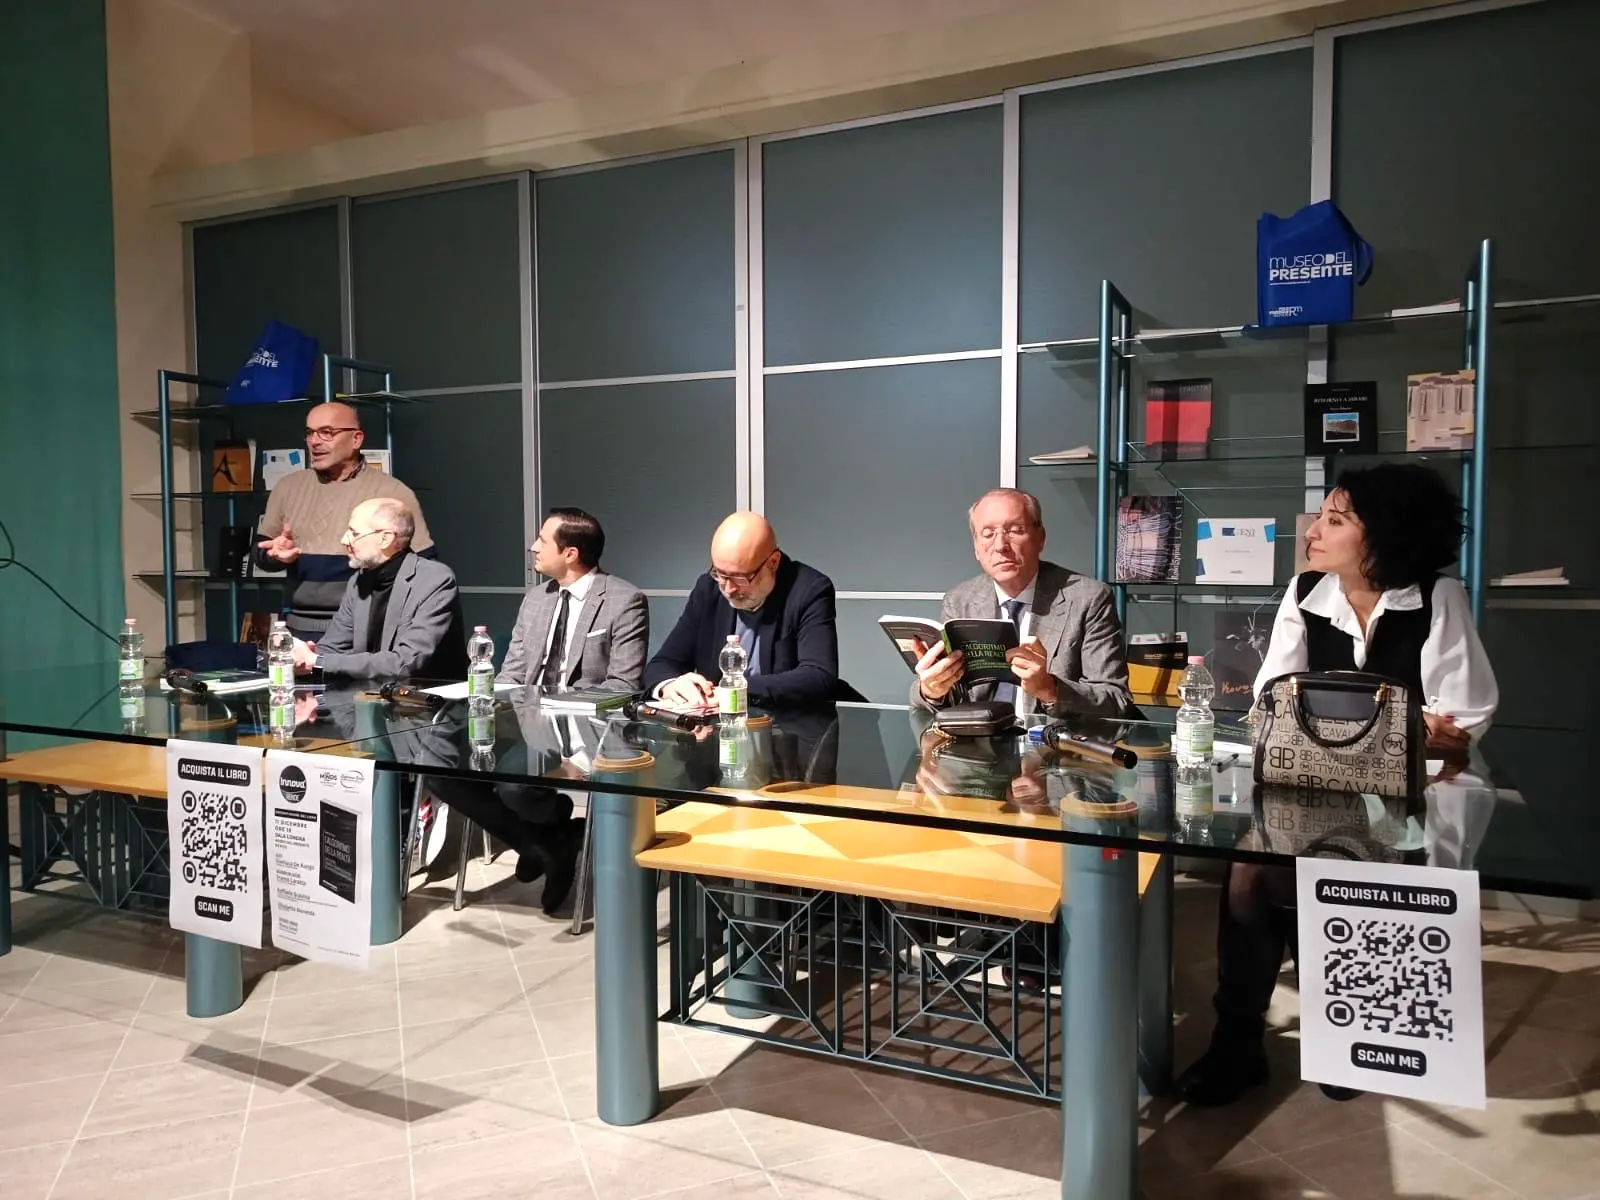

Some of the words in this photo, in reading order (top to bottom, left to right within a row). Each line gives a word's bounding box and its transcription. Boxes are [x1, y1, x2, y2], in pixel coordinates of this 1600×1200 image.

[181, 764, 216, 778] ACQUISTA
[217, 767, 225, 779] IL
[226, 768, 248, 781] LIBRO
[1321, 885, 1389, 902] ACQUISTA
[1393, 891, 1405, 904] IL
[1409, 893, 1450, 908] LIBRO
[197, 902, 218, 914] SCAN
[219, 904, 231, 916] ME
[1357, 1049, 1396, 1066] SCAN
[1398, 1054, 1421, 1070] ME
